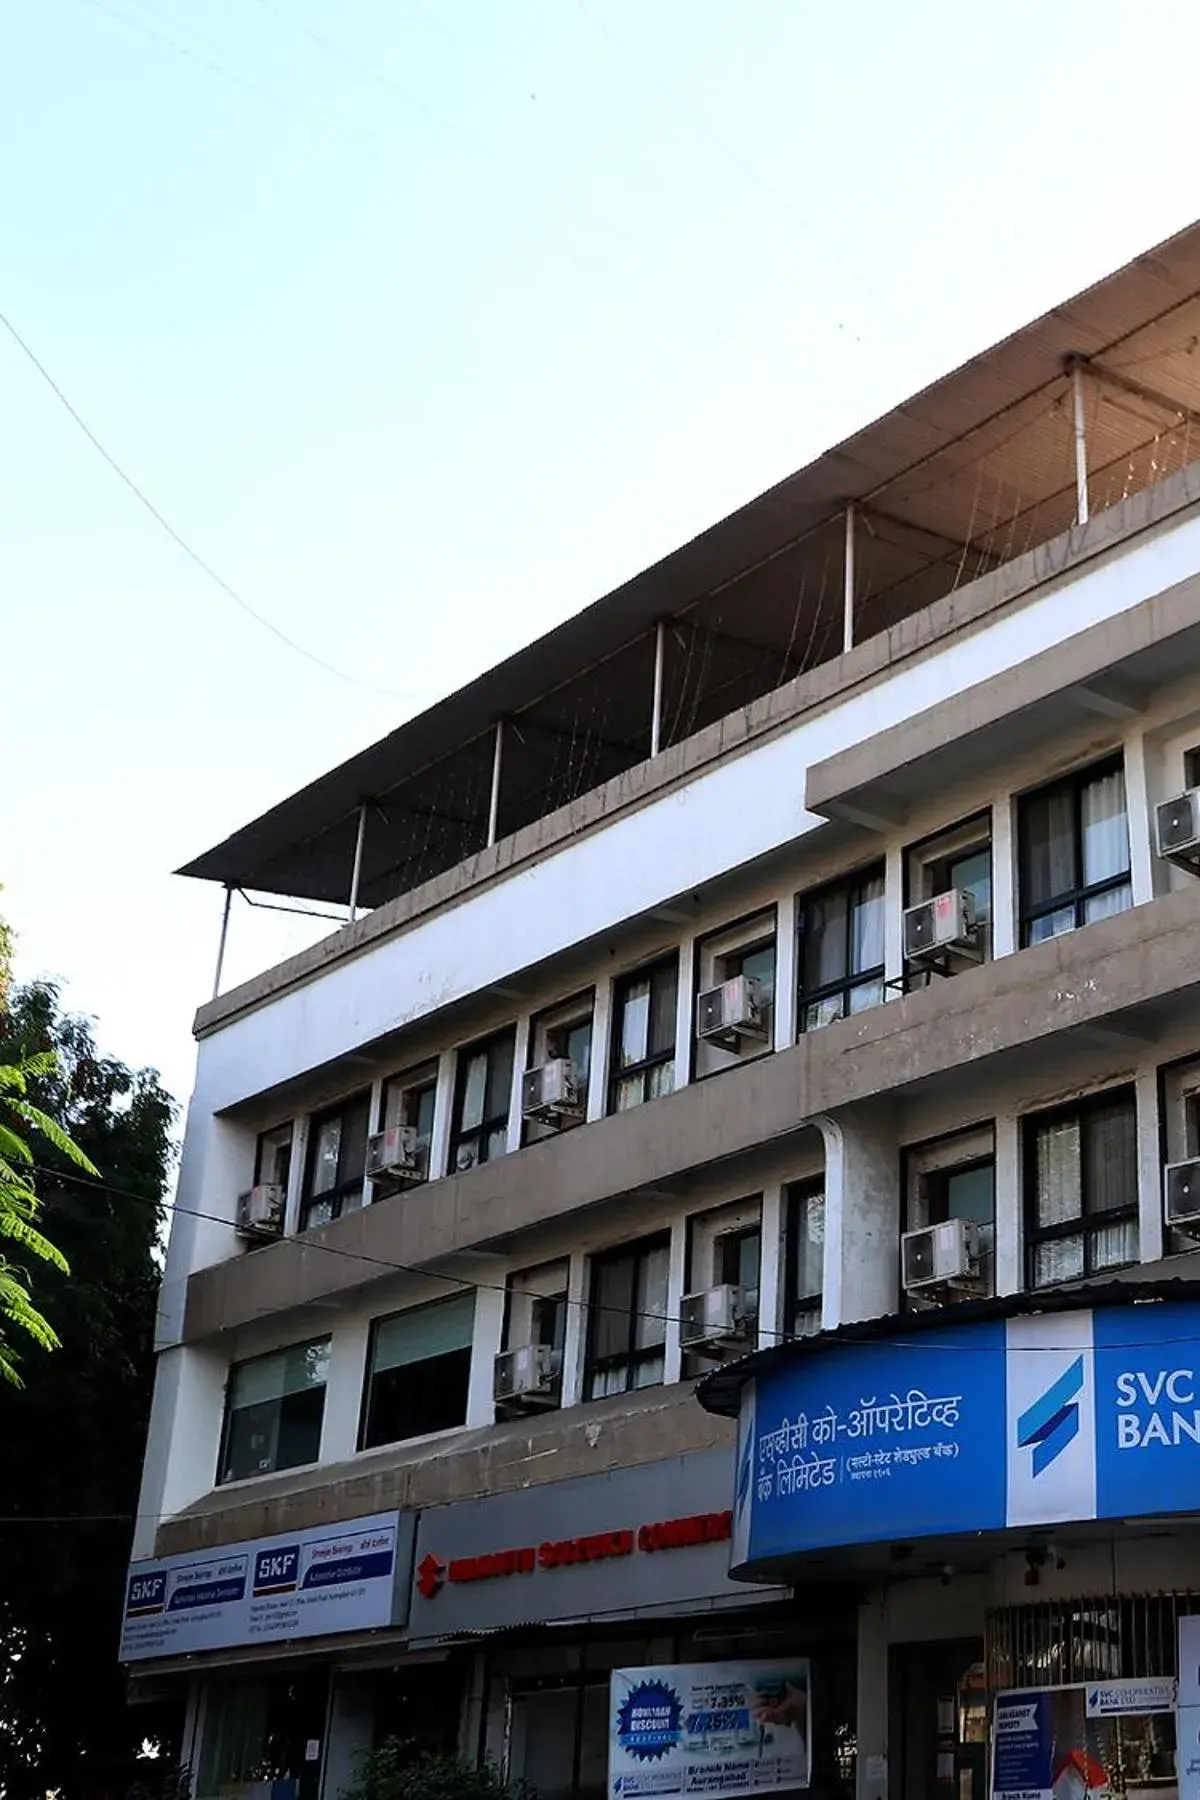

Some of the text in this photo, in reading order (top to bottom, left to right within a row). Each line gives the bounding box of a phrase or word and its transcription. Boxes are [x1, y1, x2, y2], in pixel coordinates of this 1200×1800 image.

[1115, 1369, 1194, 1407] SVC
[812, 1389, 963, 1443] को-ऑपरेटिव्ह
[777, 1451, 836, 1497] लिमिटेड
[259, 1553, 295, 1579] SKF
[131, 1578, 162, 1601] SKF
[631, 1718, 671, 1731] DISCOUNT
[688, 1762, 722, 1776] Branch
[724, 1761, 750, 1772] Name
[691, 1773, 746, 1786] Aurangabad
